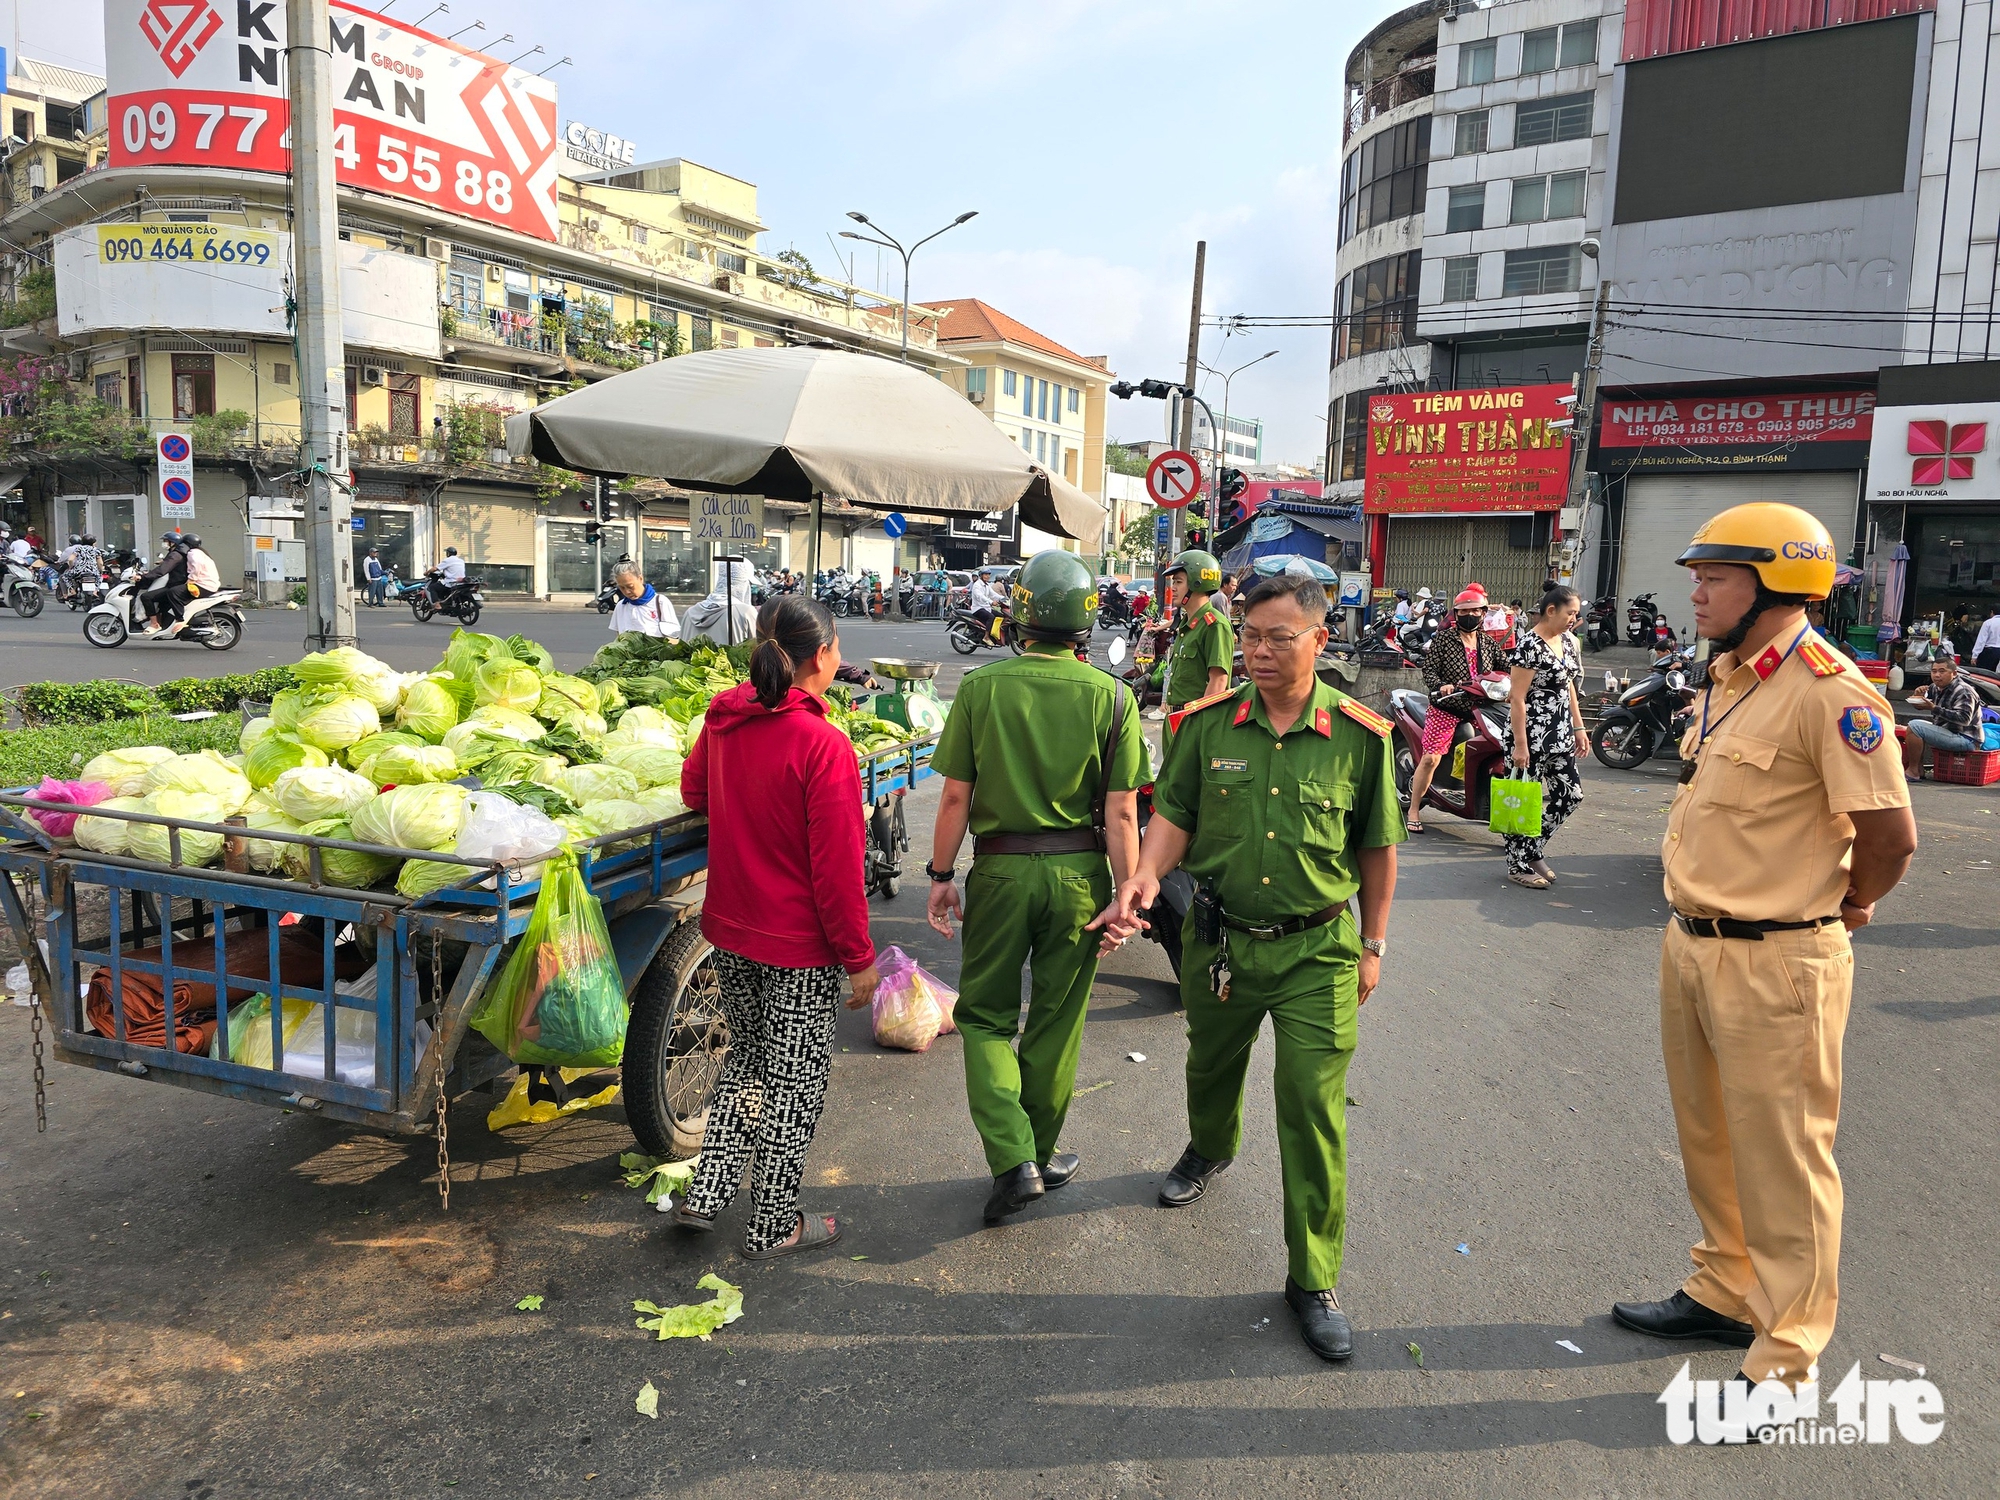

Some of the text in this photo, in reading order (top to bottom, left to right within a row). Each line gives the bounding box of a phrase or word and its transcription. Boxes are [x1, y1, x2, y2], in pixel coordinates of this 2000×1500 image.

[238, 0, 365, 62] KM
[371, 52, 424, 81] GROUP
[238, 43, 426, 124] NAN
[567, 121, 636, 164] CORE
[123, 102, 176, 153] 09
[188, 103, 268, 153] 77
[377, 134, 442, 193] 55
[454, 160, 513, 214] 88
[196, 225, 218, 235] CÁO
[105, 238, 270, 265] 090 464 6699
[1413, 391, 1524, 415] TIỆM VÀNG
[1613, 393, 1877, 424] NHÀ CHO THUÊ
[1373, 413, 1567, 456] VĨNH THÀNH
[1628, 425, 1648, 436] LH:
[1652, 423, 1685, 435] 0934
[1690, 423, 1714, 434] 181
[1718, 421, 1744, 433] 678
[1757, 420, 1793, 432] 0903
[1797, 419, 1824, 430] 905
[1684, 435, 1720, 444] TIÊN
[1727, 433, 1767, 443] NGÂN
[1772, 432, 1818, 442] HÀNG
[1643, 456, 1656, 465] BÙI
[1657, 455, 1675, 465] HỮU
[1733, 454, 1754, 464] BÌNH
[1756, 454, 1788, 464] THẠNH
[1496, 479, 1540, 492] THÀNH
[1893, 489, 1904, 497] BÙI
[1906, 488, 1922, 497] HỮU
[1924, 488, 1949, 497] NGHĨA
[955, 541, 978, 550] Welcome
[1781, 541, 1835, 563] CSGT
[1865, 730, 1878, 738] GT
